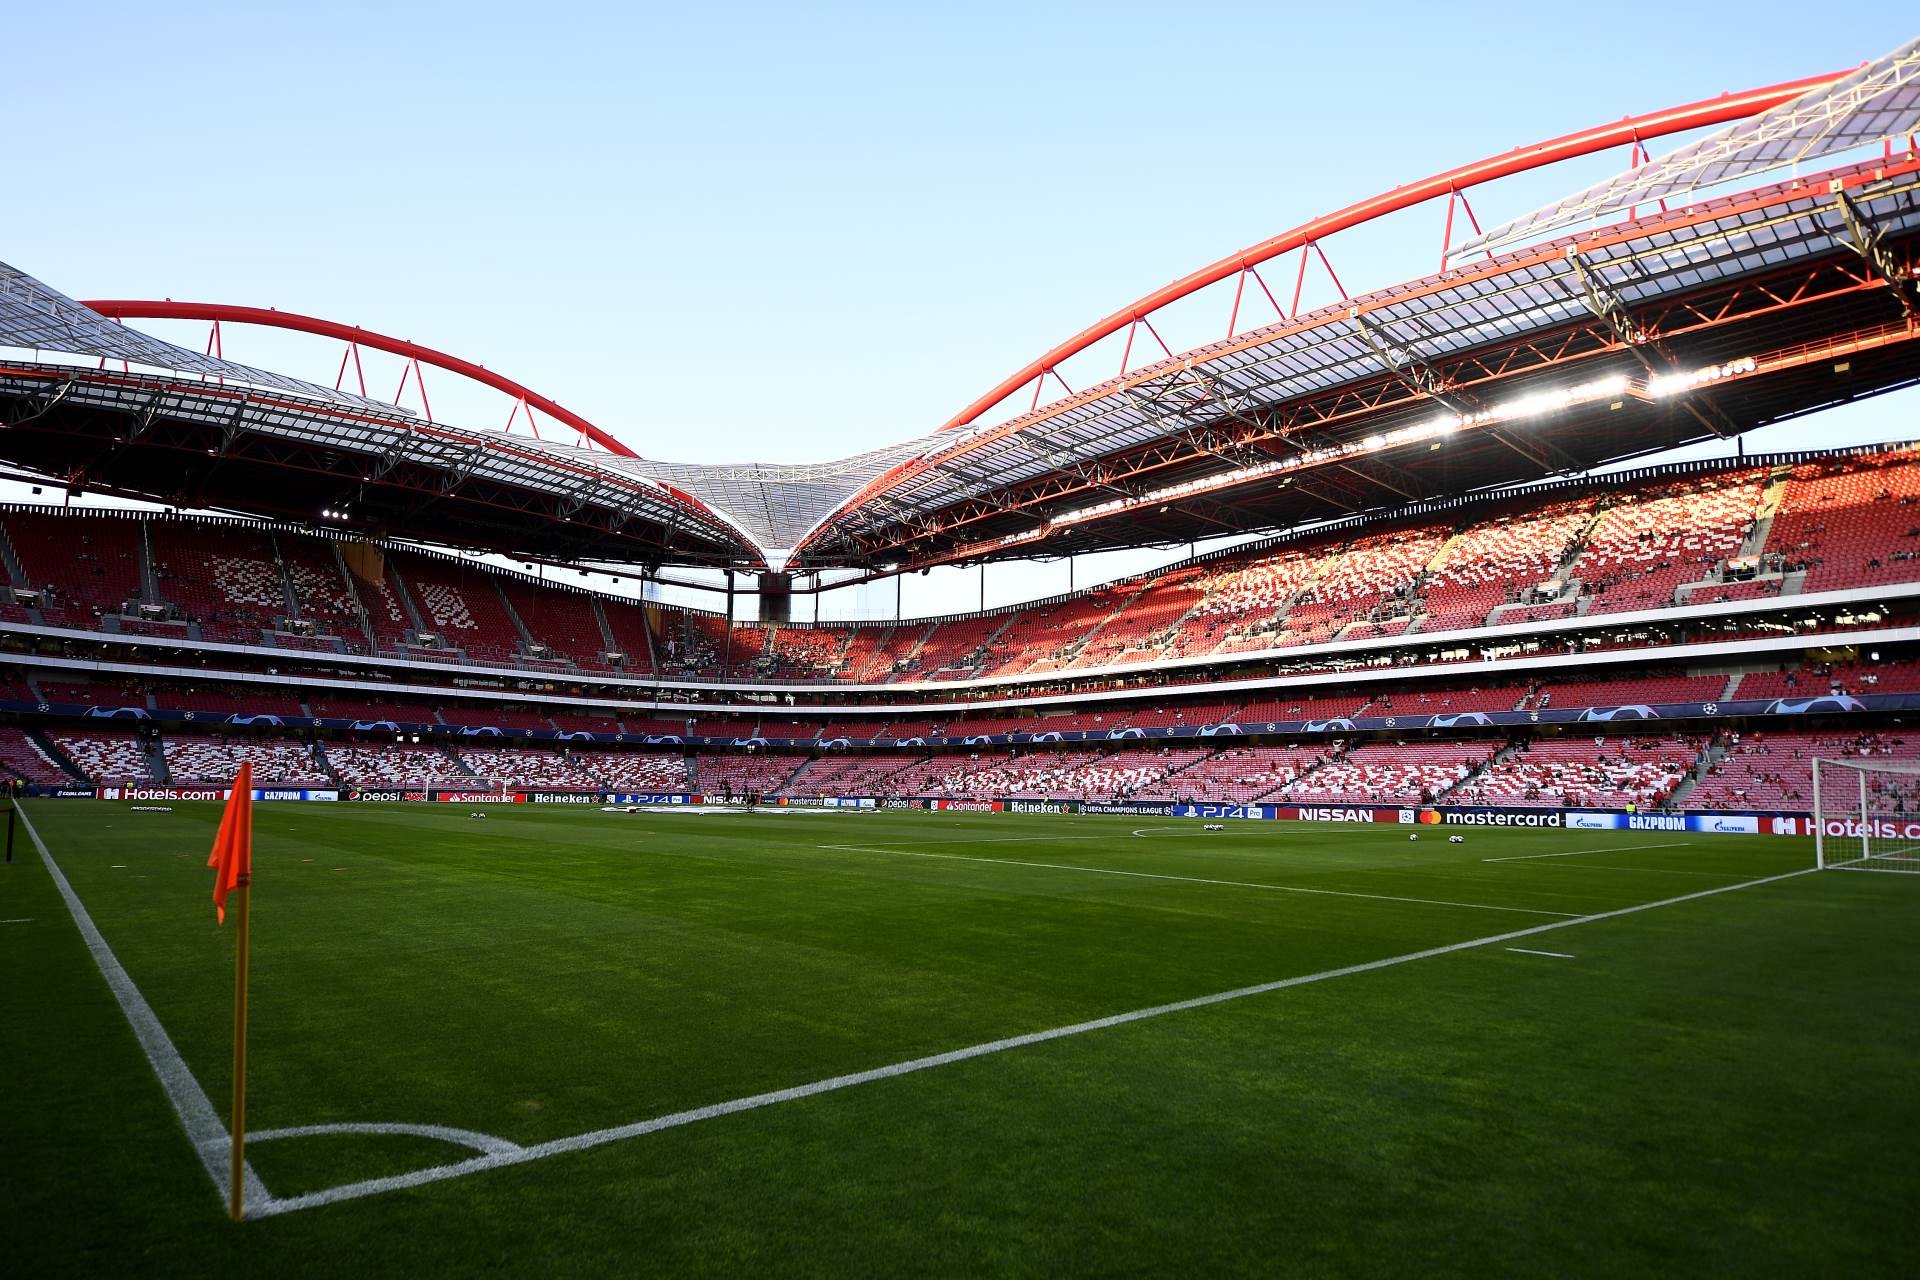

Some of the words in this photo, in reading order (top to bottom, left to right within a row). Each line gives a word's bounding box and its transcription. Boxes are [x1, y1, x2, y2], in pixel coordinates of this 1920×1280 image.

[124, 788, 216, 800] Hotels.com
[264, 791, 301, 800] GAZPROM
[362, 791, 400, 802] pepsi
[461, 793, 516, 803] Santander
[535, 793, 590, 804] Heineken
[637, 796, 670, 804] PS4
[789, 798, 822, 806] mastercard
[888, 800, 909, 809] pepsi
[954, 800, 993, 812] Santander
[1011, 802, 1060, 814] Heineken
[1103, 806, 1138, 814] CHAMPIONS
[1138, 807, 1163, 815] LEAGUE
[1203, 807, 1245, 819] PS4
[1249, 809, 1261, 817] Pro
[1299, 808, 1374, 823] NISSAN
[1446, 811, 1560, 827] mastercard
[1629, 815, 1686, 831] GAZPROM
